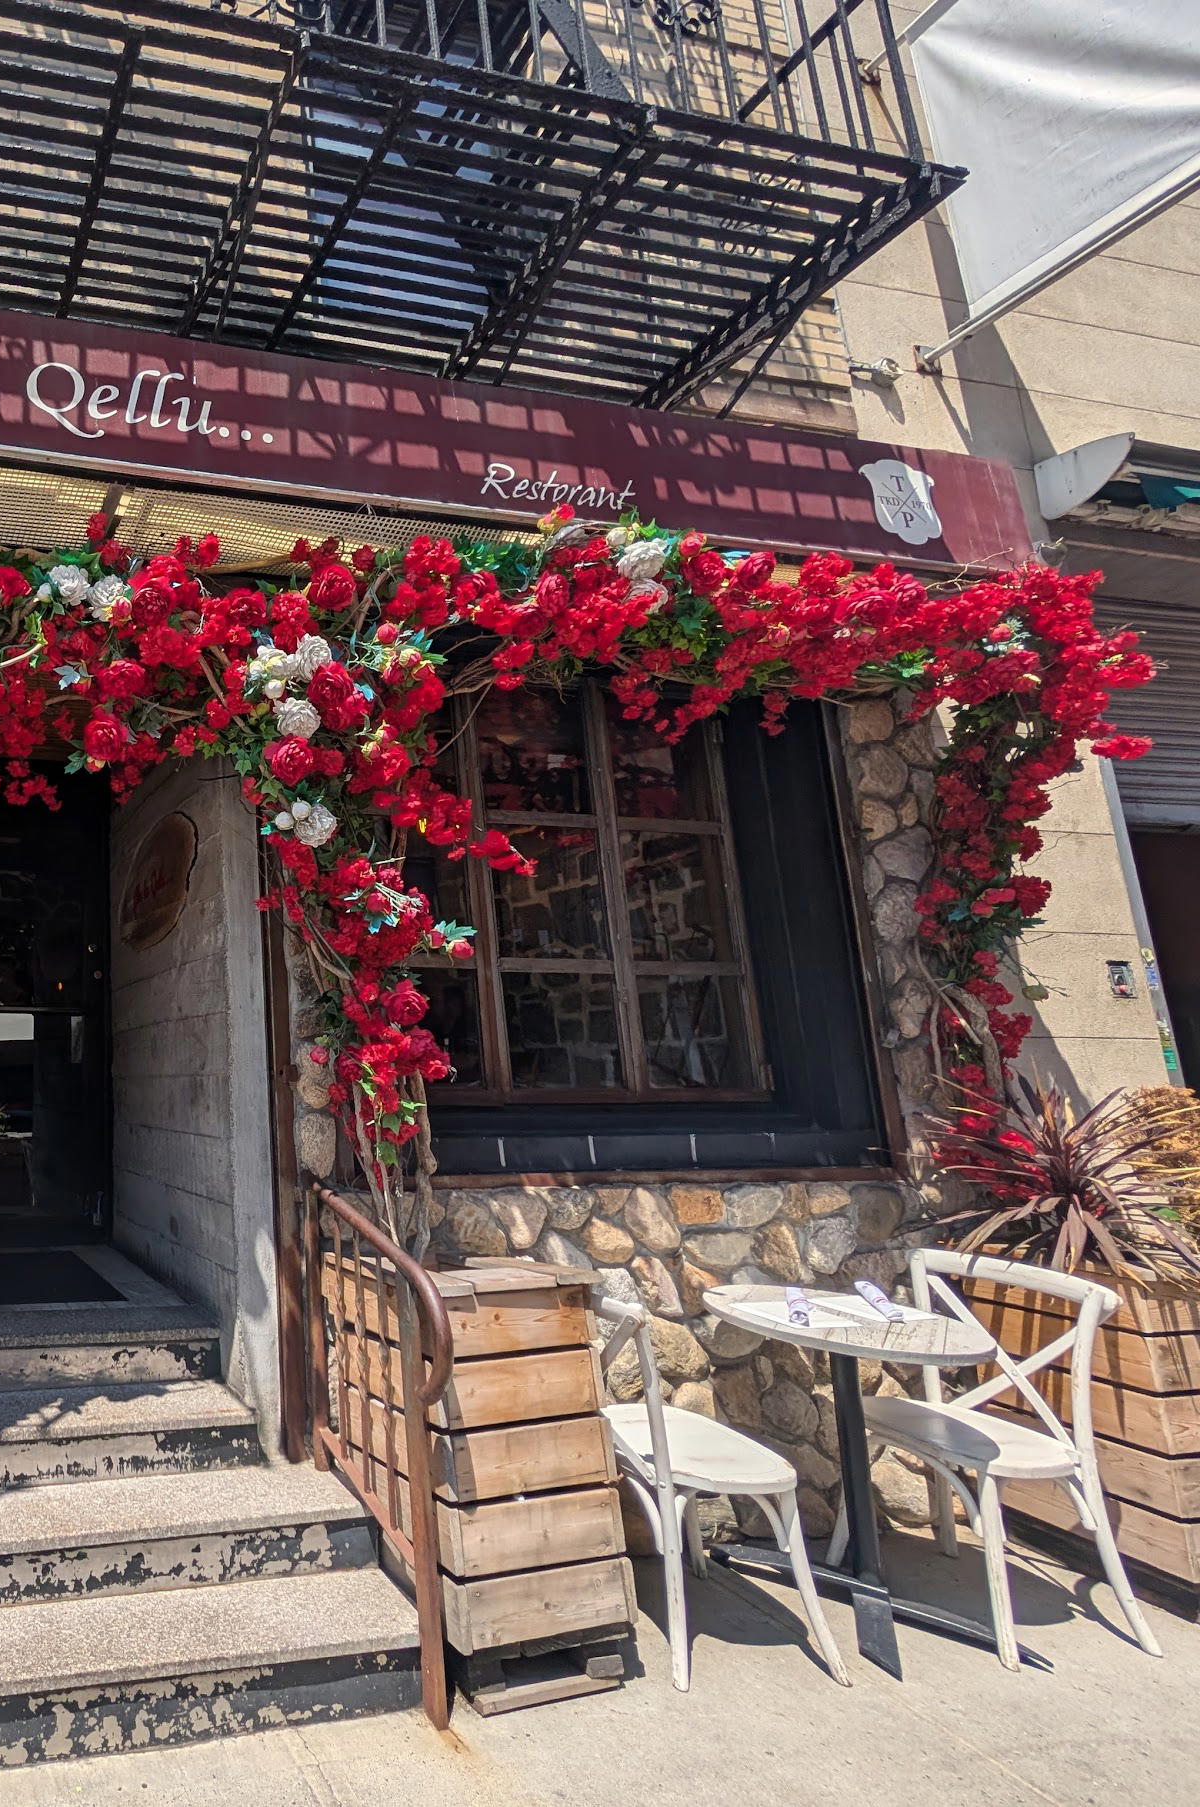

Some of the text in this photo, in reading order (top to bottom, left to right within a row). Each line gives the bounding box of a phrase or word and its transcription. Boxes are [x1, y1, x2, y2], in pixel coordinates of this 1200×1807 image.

[480, 463, 636, 510] Restorant
[889, 475, 905, 492] T
[877, 495, 900, 507] TKD
[901, 511, 915, 528] P
